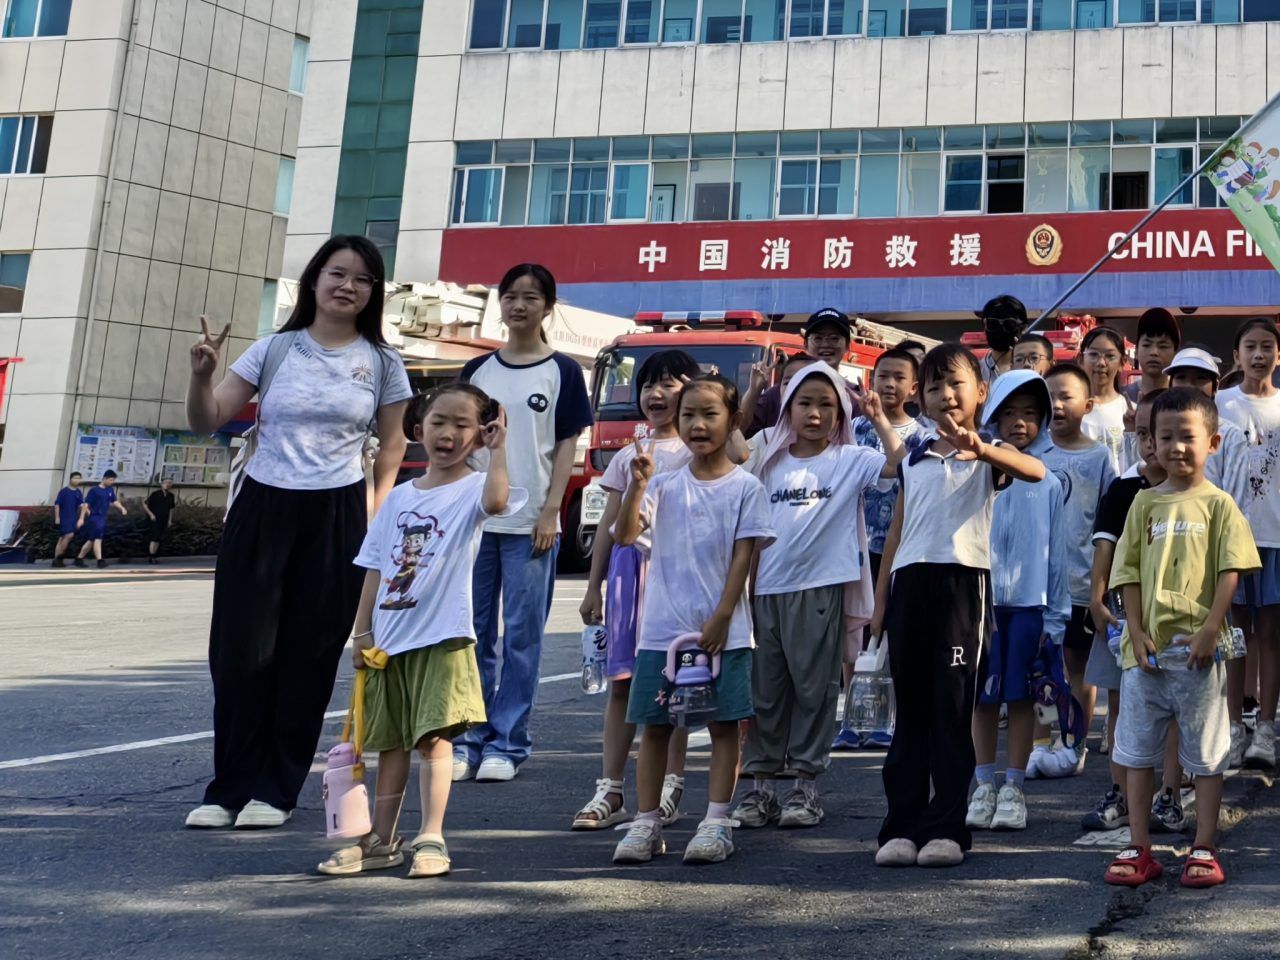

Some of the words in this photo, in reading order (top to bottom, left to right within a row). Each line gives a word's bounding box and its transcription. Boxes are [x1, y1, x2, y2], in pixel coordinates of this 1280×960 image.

[638, 232, 982, 274] 中国消防救援
[1107, 230, 1216, 259] CHINA
[1226, 229, 1264, 257] FI
[950, 646, 967, 667] R
